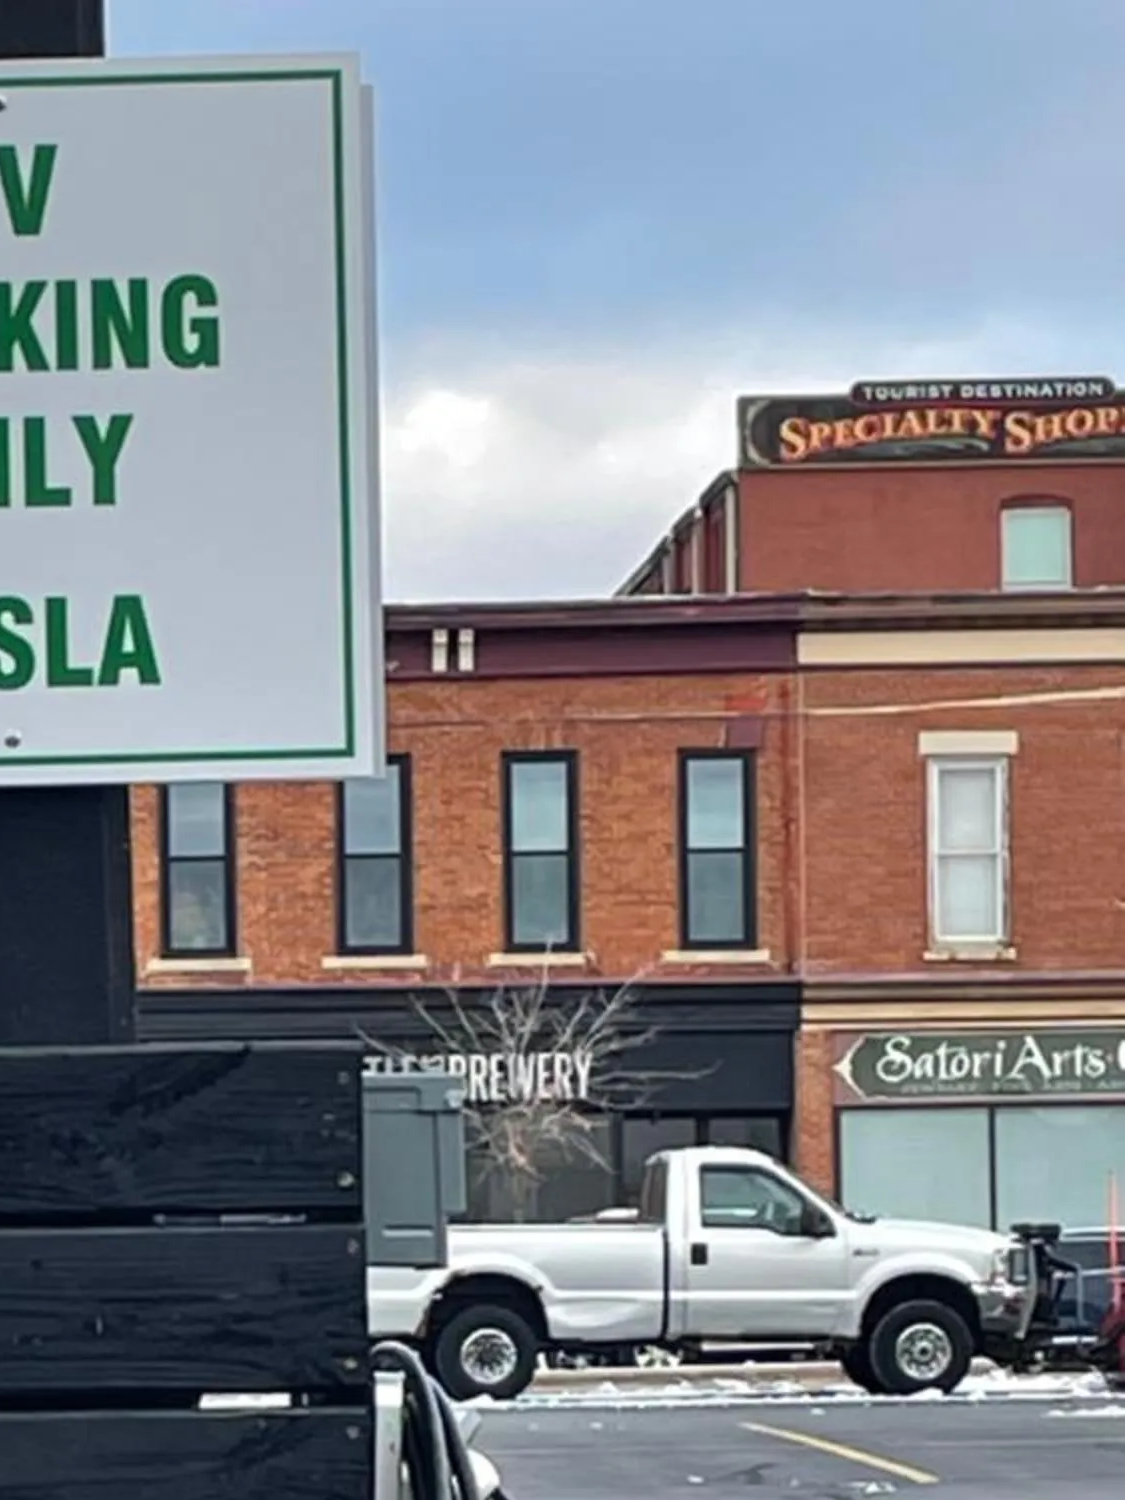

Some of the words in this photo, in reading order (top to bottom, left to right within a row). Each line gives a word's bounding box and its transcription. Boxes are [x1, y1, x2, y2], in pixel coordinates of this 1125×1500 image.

[862, 383, 953, 402] TOURIST
[959, 382, 1104, 400] DESTINATION
[779, 408, 999, 461] SPECIALTY
[1004, 406, 1125, 455] SHOP
[875, 1036, 1007, 1083] Satori
[1005, 1034, 1107, 1082] Arts
